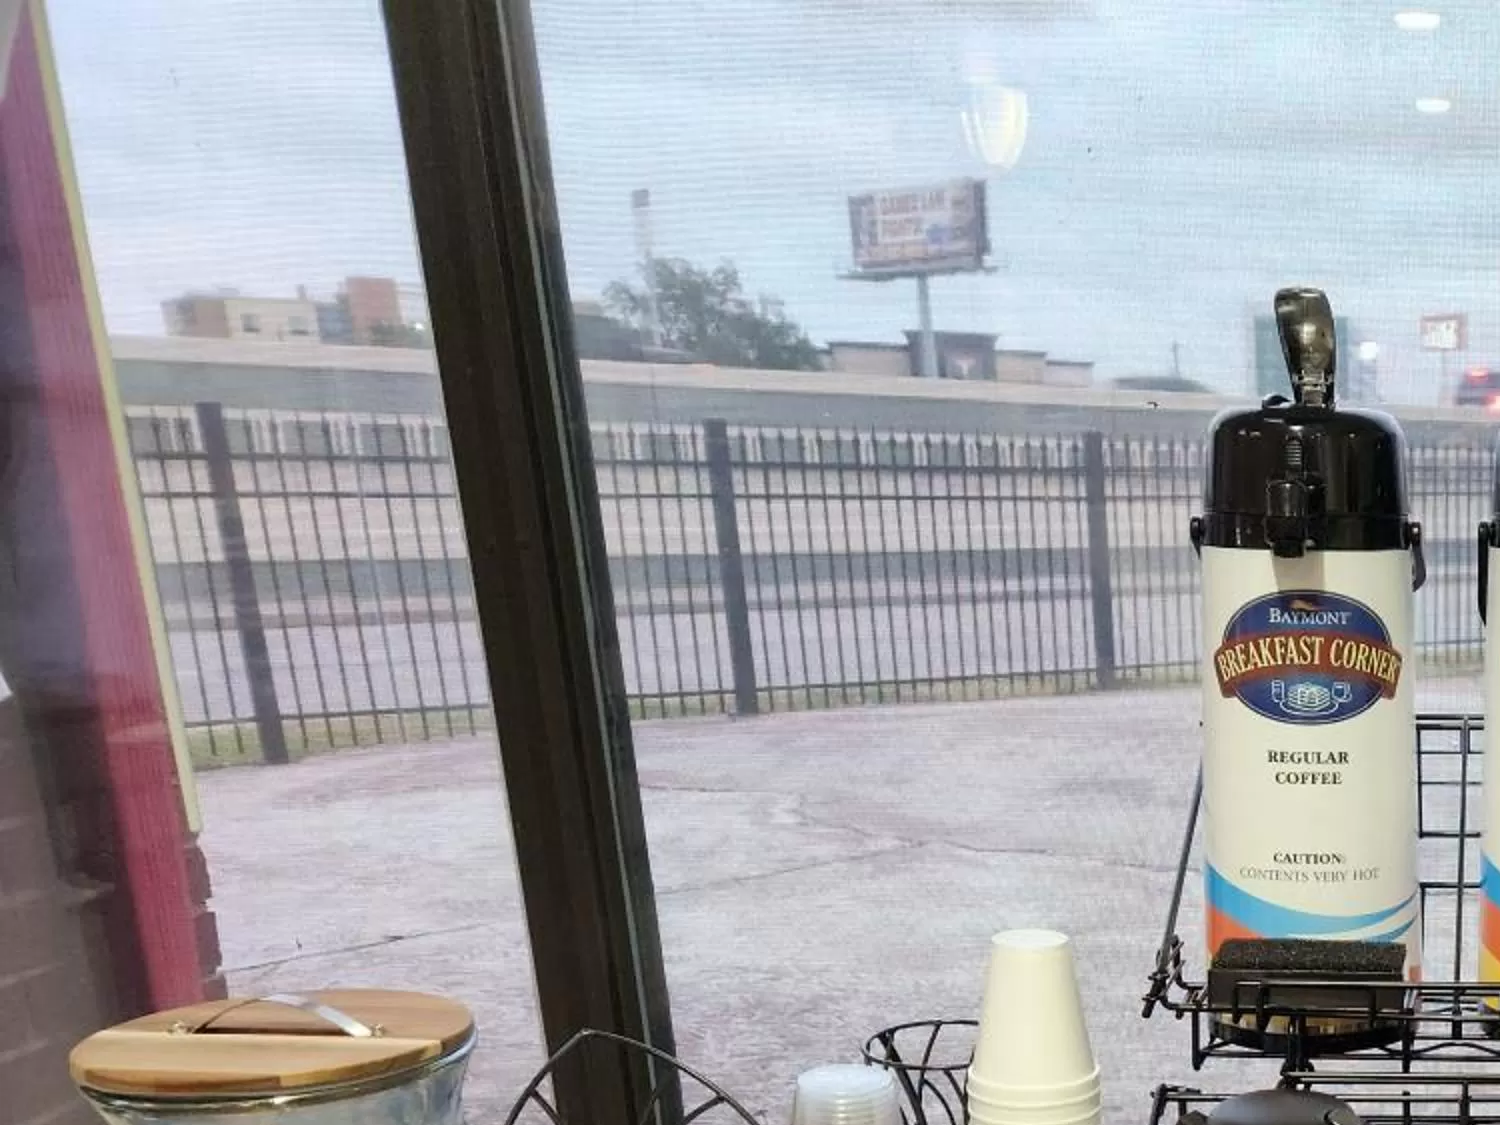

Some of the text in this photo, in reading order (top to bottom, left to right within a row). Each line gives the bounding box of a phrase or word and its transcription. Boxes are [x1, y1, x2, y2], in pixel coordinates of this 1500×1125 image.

[1217, 636, 1399, 684] BREAKFAST CORNER
[1267, 750, 1350, 765] REGULAR
[1275, 771, 1343, 786] COFFEE
[1239, 866, 1380, 883] CONTENTS VERY HOT
